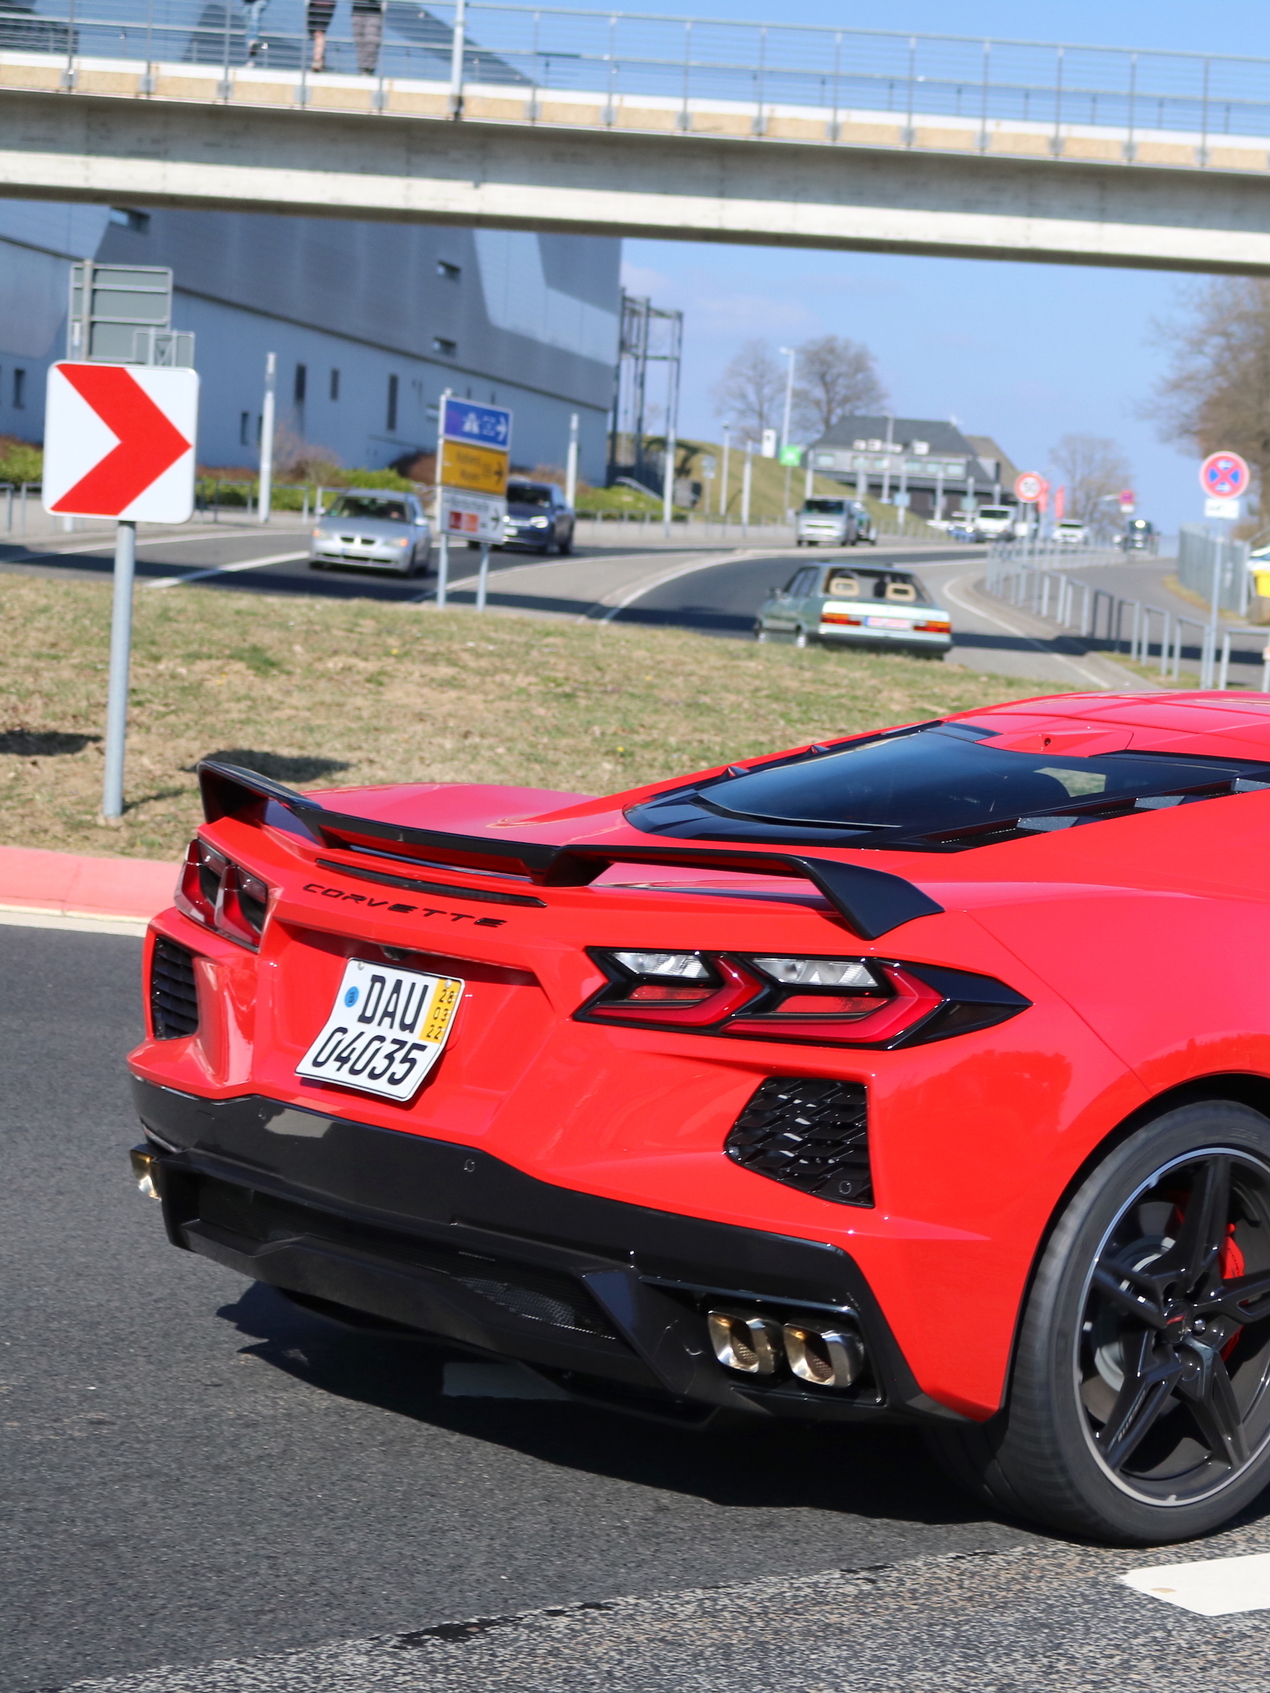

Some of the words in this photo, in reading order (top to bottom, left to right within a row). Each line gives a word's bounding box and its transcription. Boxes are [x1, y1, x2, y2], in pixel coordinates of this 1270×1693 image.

[303, 883, 508, 928] CORVETTE
[357, 974, 429, 1034] DAU
[438, 989, 457, 1004] 28
[433, 1006, 451, 1022] 03
[426, 1024, 445, 1040] 22
[311, 1026, 428, 1086] 04035
